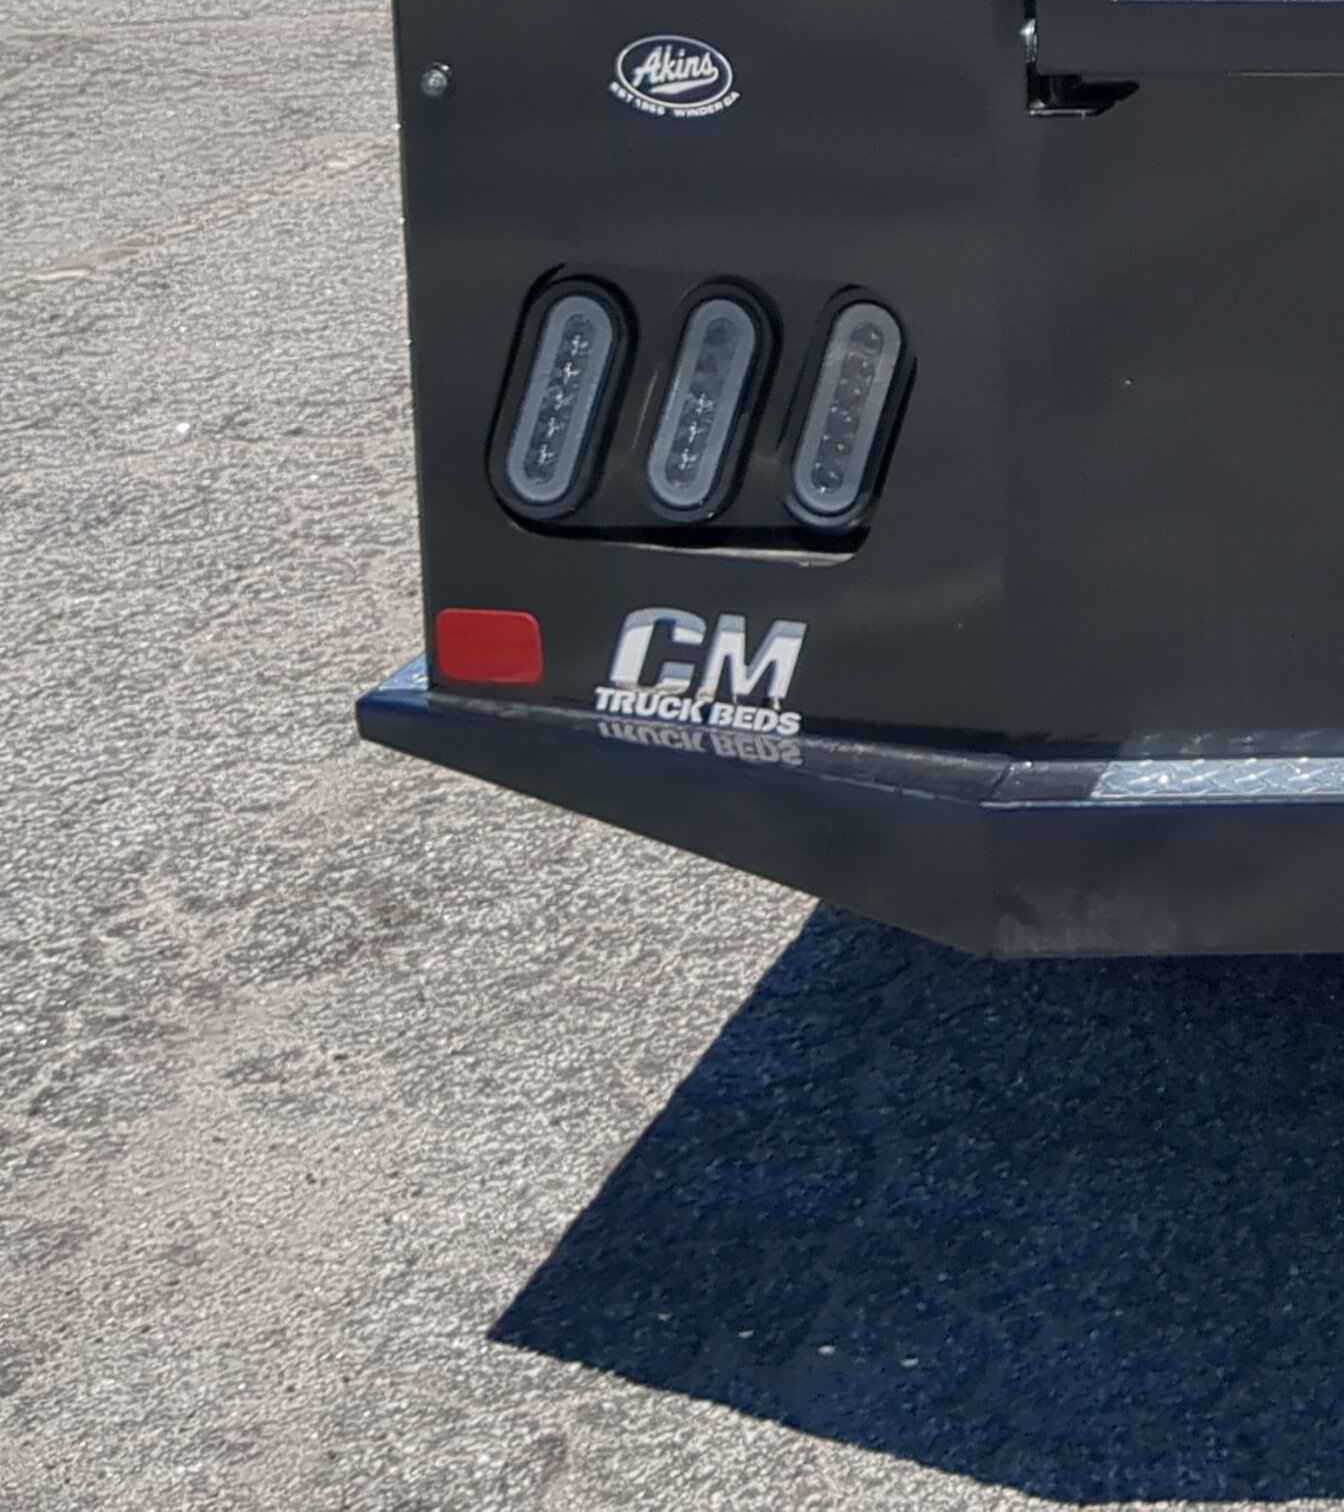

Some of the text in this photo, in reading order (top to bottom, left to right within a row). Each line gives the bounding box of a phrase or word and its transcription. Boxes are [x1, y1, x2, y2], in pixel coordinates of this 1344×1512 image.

[633, 46, 718, 87] Akins
[675, 103, 722, 117] WINDER
[609, 607, 808, 700] CM
[594, 687, 800, 733] TRUCK BEDS
